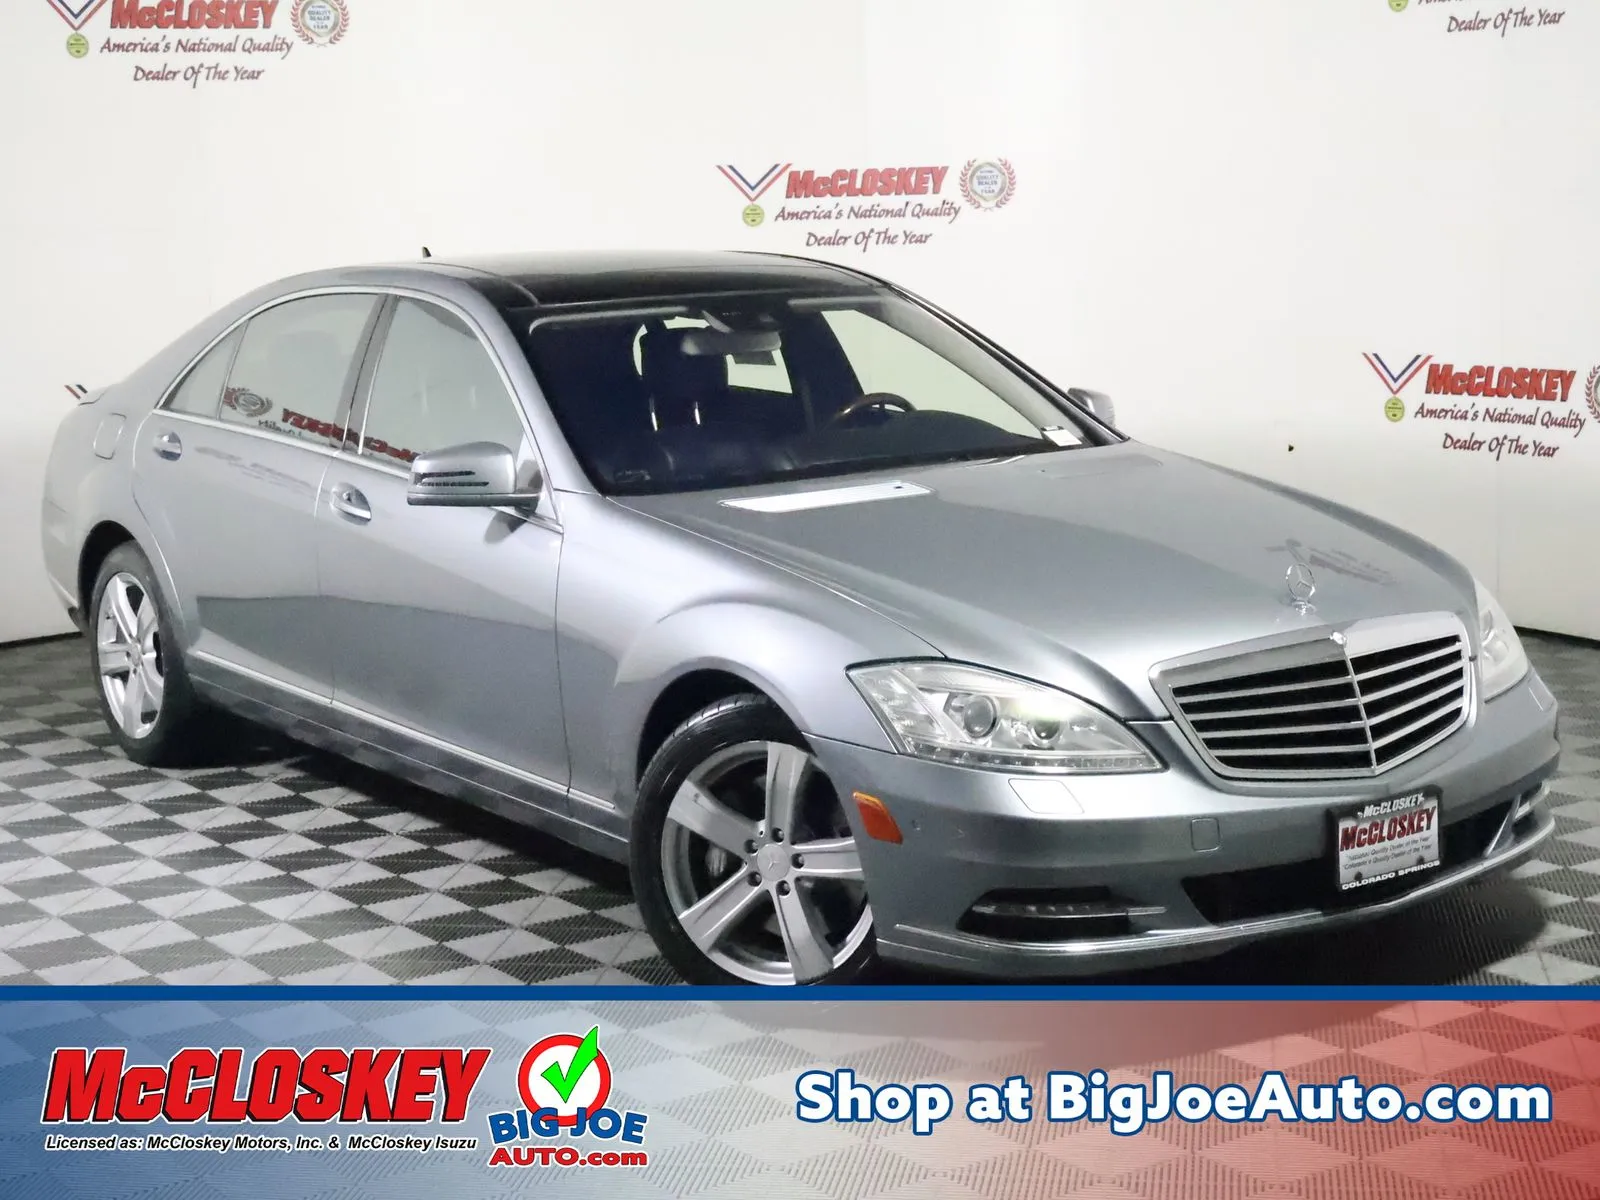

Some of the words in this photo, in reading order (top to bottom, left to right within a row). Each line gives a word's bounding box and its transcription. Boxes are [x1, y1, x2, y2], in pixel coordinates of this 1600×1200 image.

[110, 0, 279, 29] McCLOSKEY
[1447, 11, 1492, 33] Dealer
[1493, 8, 1513, 38] Of
[1513, 6, 1534, 28] The
[1537, 8, 1566, 26] Year
[100, 34, 171, 54] America's
[175, 36, 236, 53] National
[241, 34, 293, 60] Quality
[133, 63, 180, 81] Dealer
[183, 62, 204, 88] Of
[204, 63, 229, 81] The
[232, 65, 264, 81] Year
[785, 165, 949, 199] McCLOSKEY
[775, 202, 843, 221] America's
[847, 201, 906, 219] National
[911, 199, 962, 224] Quality
[806, 229, 851, 247] Dealer
[854, 228, 875, 253] Of
[875, 227, 899, 245] The
[902, 228, 932, 246] Year
[1425, 363, 1576, 402] McCLOSKEY
[1414, 402, 1479, 422] America's
[1483, 407, 1539, 426] National
[1540, 409, 1586, 438] Quality
[1442, 432, 1486, 452] Dealer
[1488, 433, 1508, 461] Of
[1508, 435, 1529, 456] The
[1531, 440, 1559, 458] Year
[1363, 793, 1424, 818] McCLOSKEY
[1340, 806, 1436, 851] McCLOSKEY
[1342, 872, 1396, 890] COLORADO
[1398, 860, 1440, 876] SPRINGS
